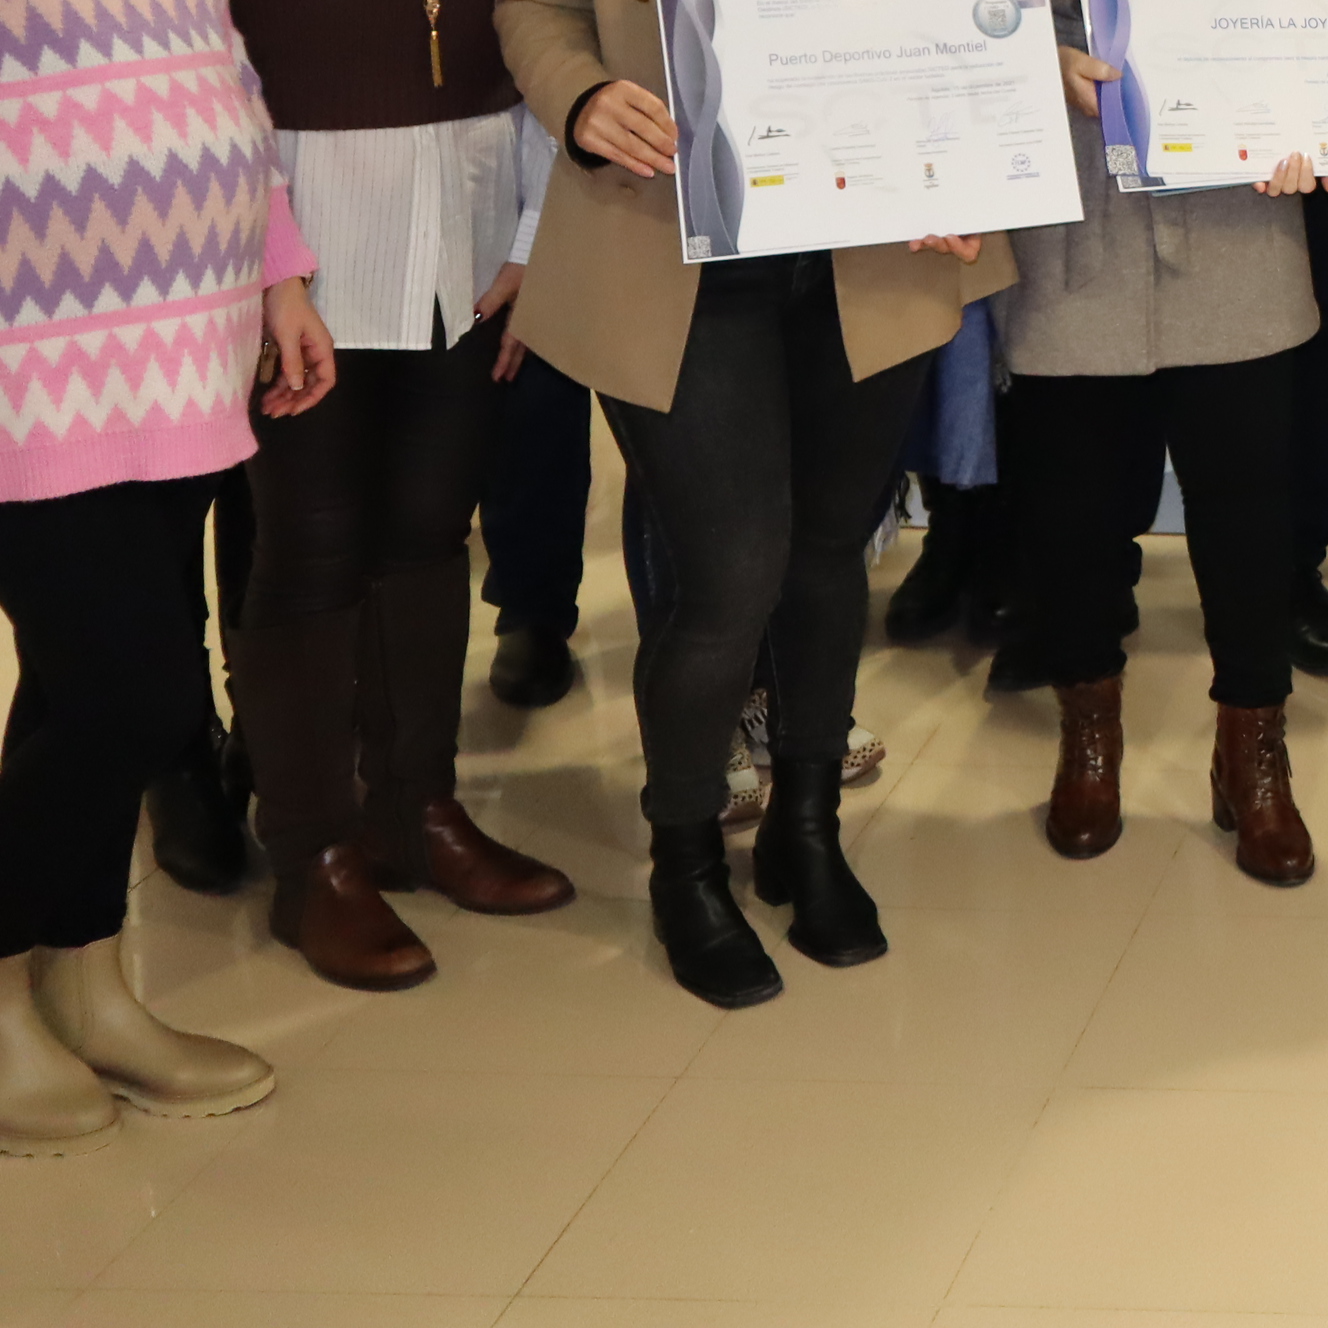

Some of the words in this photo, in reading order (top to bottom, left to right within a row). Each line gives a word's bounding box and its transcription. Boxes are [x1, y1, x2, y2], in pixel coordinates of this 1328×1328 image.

[1210, 15, 1275, 30] JOYERÍA
[1279, 17, 1297, 30] LA
[768, 51, 818, 67] Puerto
[822, 47, 892, 65] Deportivo
[896, 45, 931, 59] Juan
[935, 39, 988, 56] Montiel
